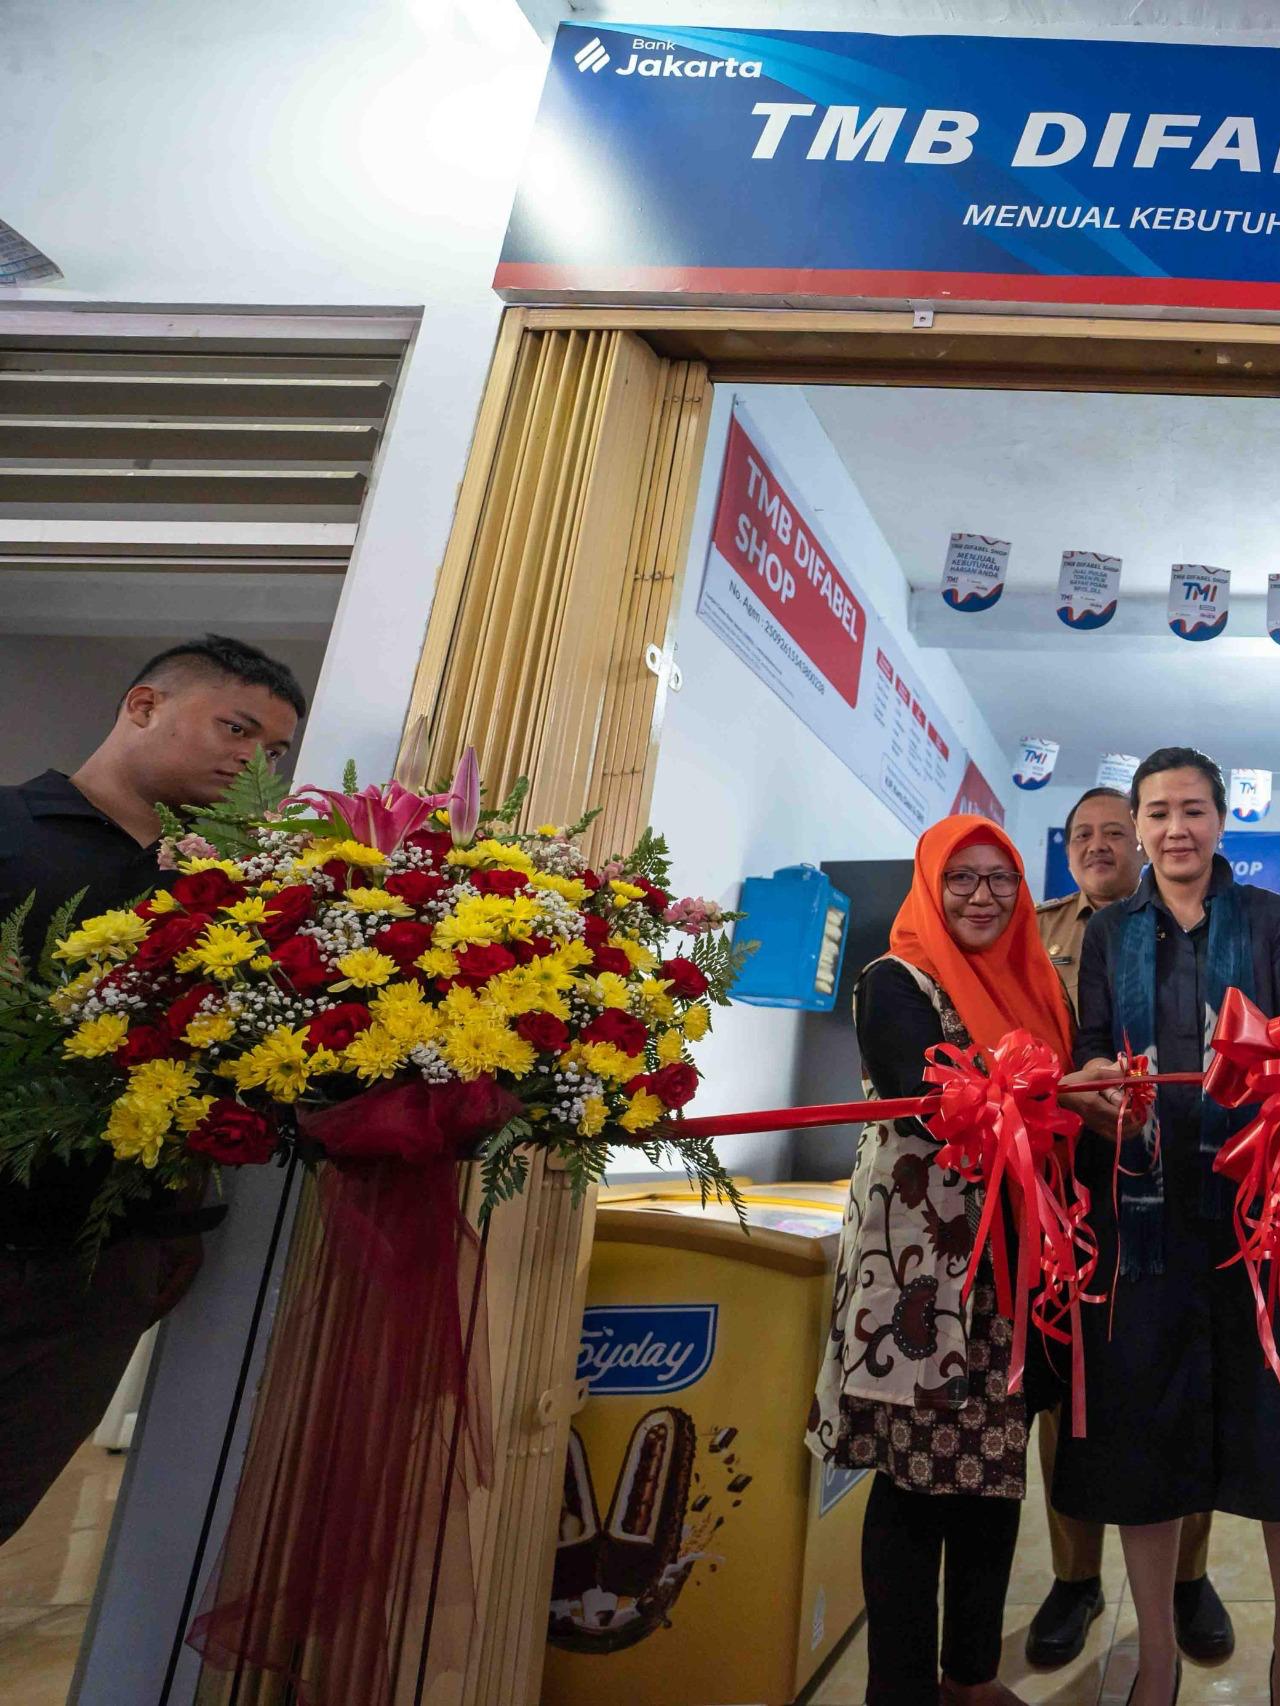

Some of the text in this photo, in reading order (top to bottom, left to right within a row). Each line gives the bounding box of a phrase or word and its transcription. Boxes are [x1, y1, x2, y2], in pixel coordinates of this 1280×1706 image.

[632, 38, 676, 50] Bank
[615, 54, 763, 79] Jakarta
[751, 102, 975, 165] TMB
[962, 203, 1122, 230] MENJUAL
[735, 513, 797, 604] SHOP
[747, 455, 793, 546] TMB
[794, 528, 858, 643] DIFABEL
[957, 552, 996, 565] MENJUAL
[951, 559, 1000, 572] KEBUTUHAN
[1183, 581, 1218, 603] TMI
[1024, 749, 1048, 765] TMI
[576, 1330, 696, 1382] oyday
